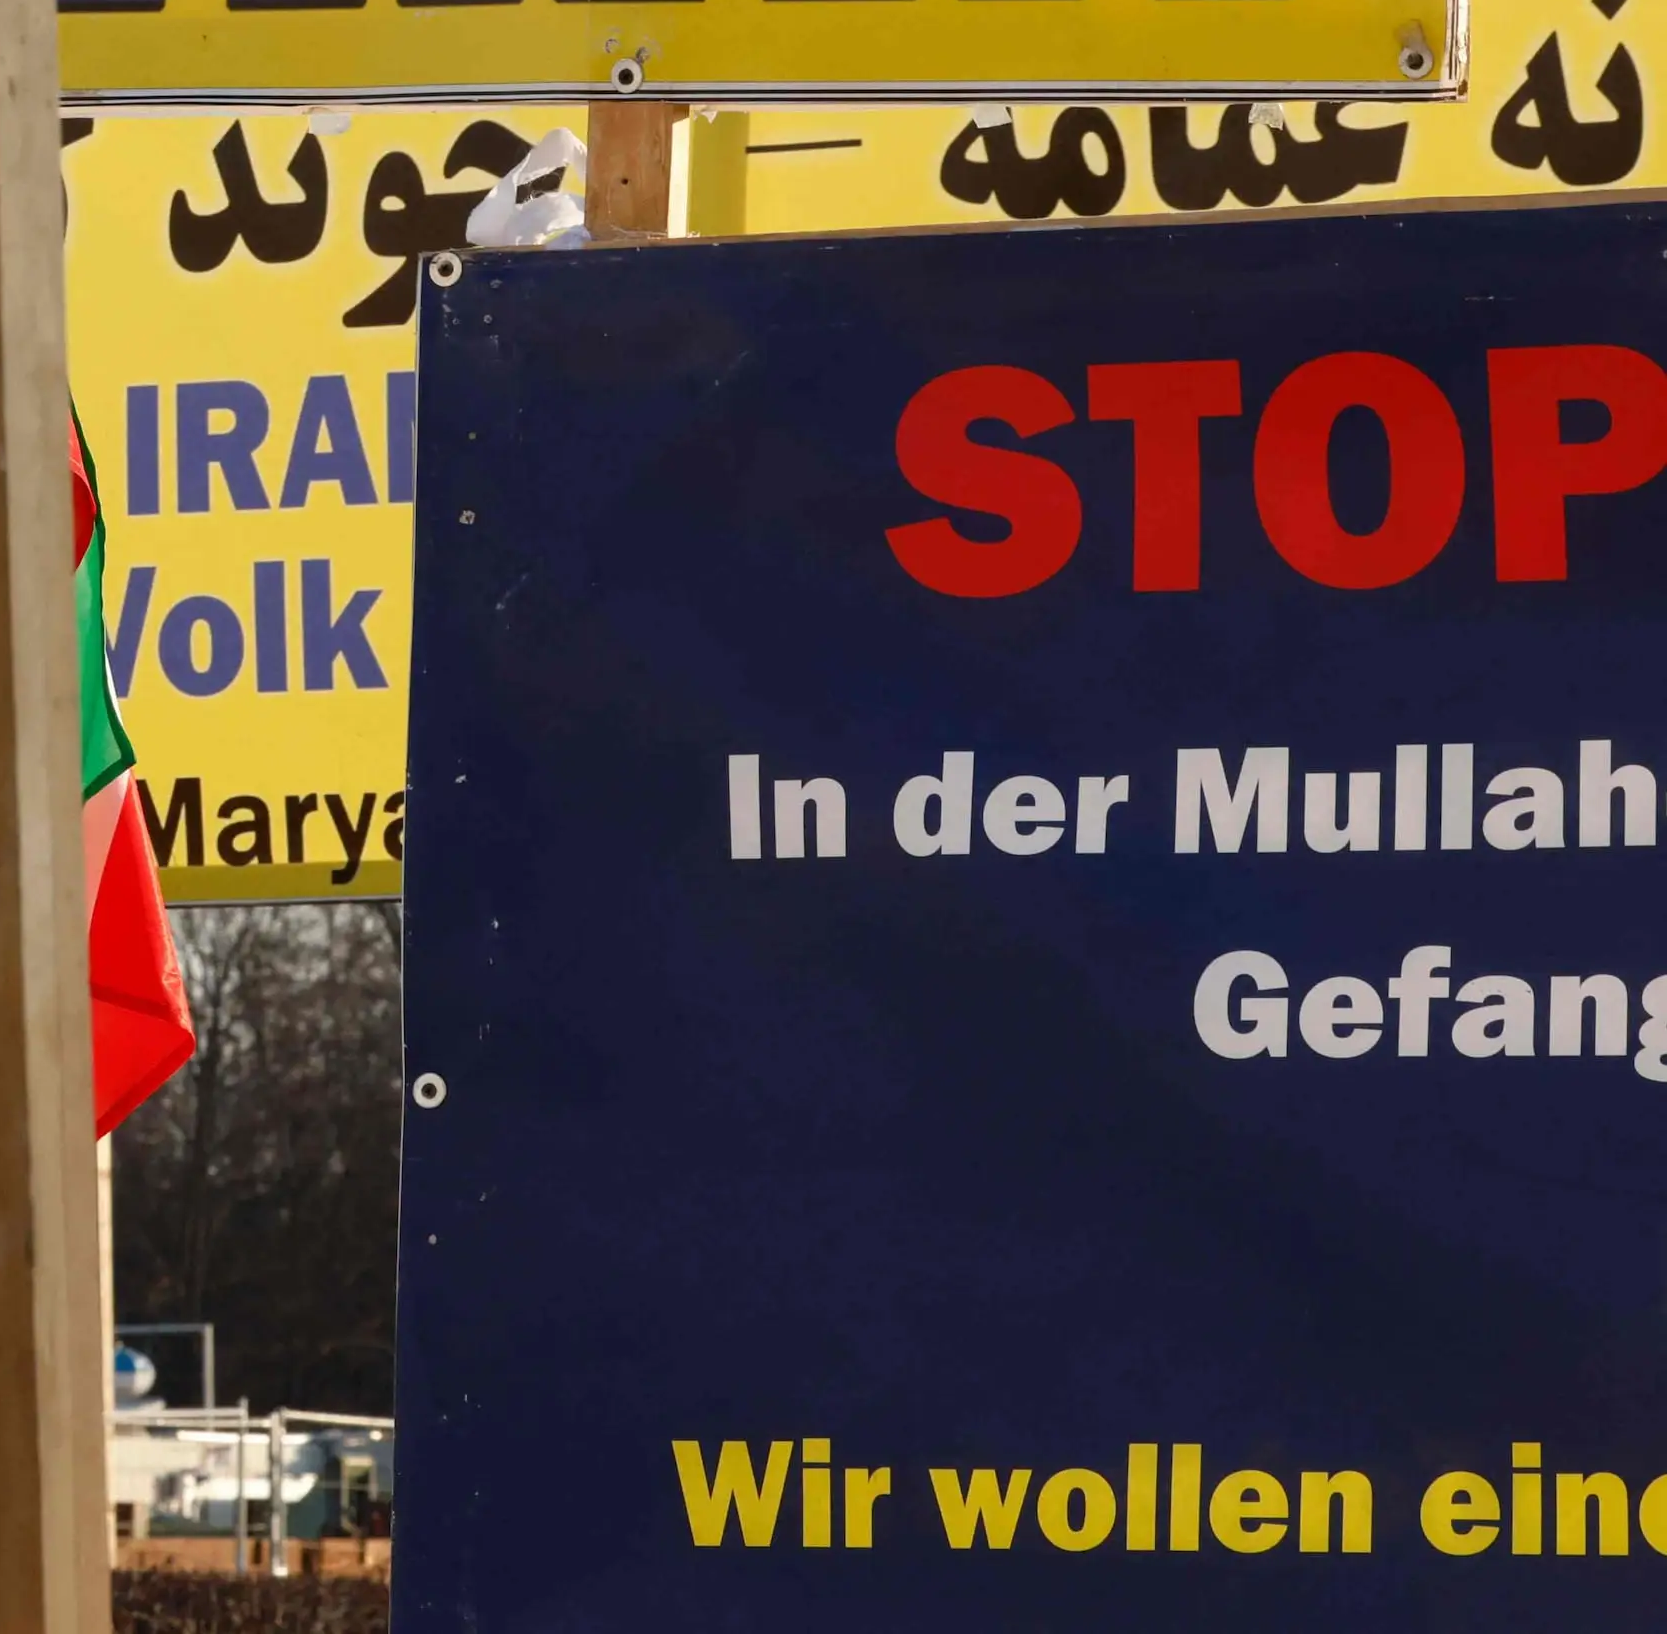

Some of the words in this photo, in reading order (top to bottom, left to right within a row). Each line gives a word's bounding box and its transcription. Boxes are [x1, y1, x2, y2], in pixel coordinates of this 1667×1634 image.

[884, 343, 1667, 599] STOP
[727, 752, 847, 861] In
[893, 750, 1129, 857] der
[671, 1437, 892, 1549] Wir
[928, 1442, 1374, 1554] wollen
